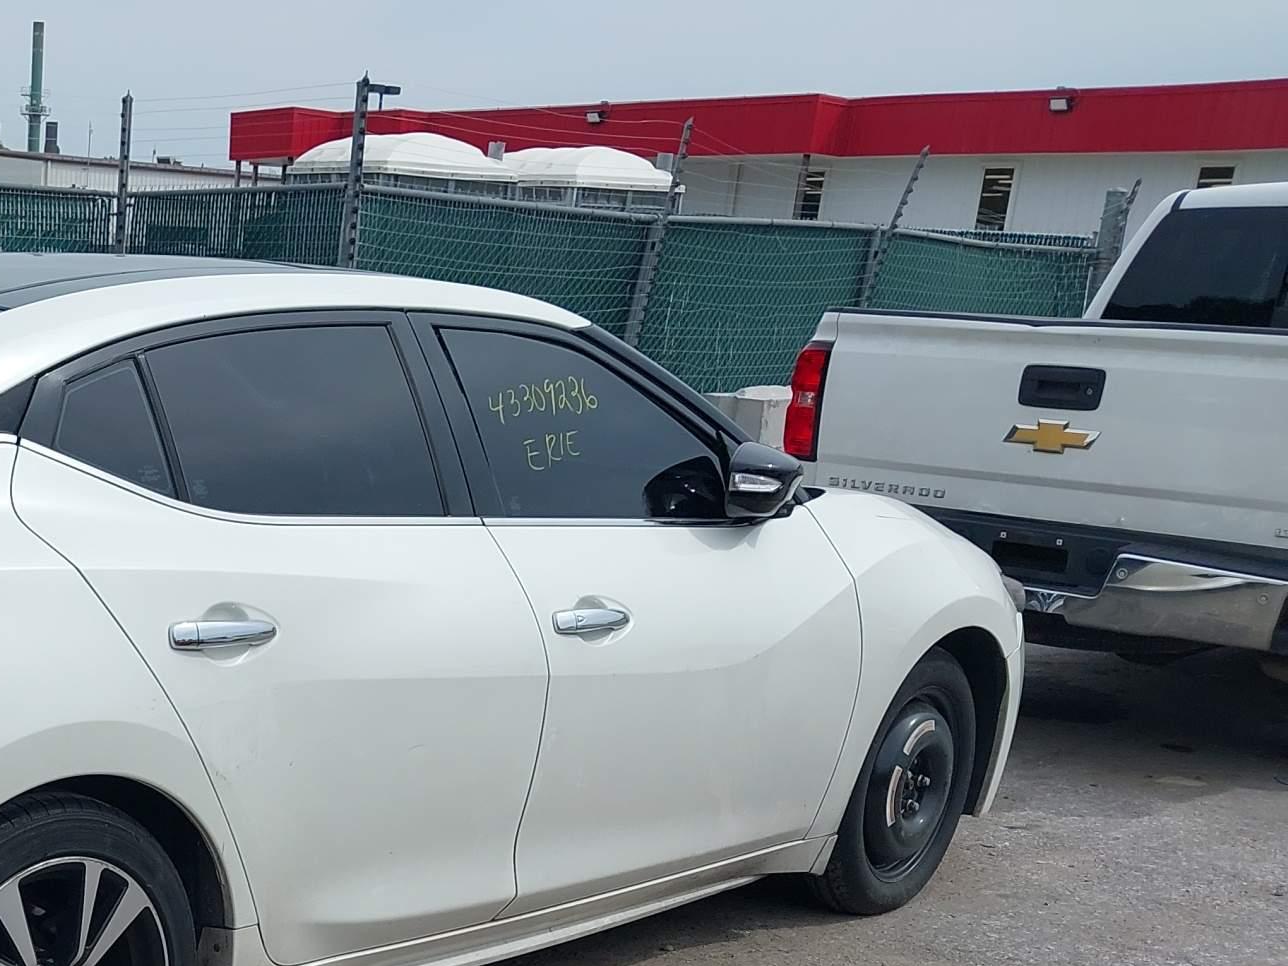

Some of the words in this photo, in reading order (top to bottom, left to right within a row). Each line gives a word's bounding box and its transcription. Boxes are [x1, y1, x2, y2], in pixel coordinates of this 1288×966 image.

[488, 375, 598, 424] 43309236
[523, 430, 580, 470] ERIE
[829, 476, 946, 499] SILVERADO
